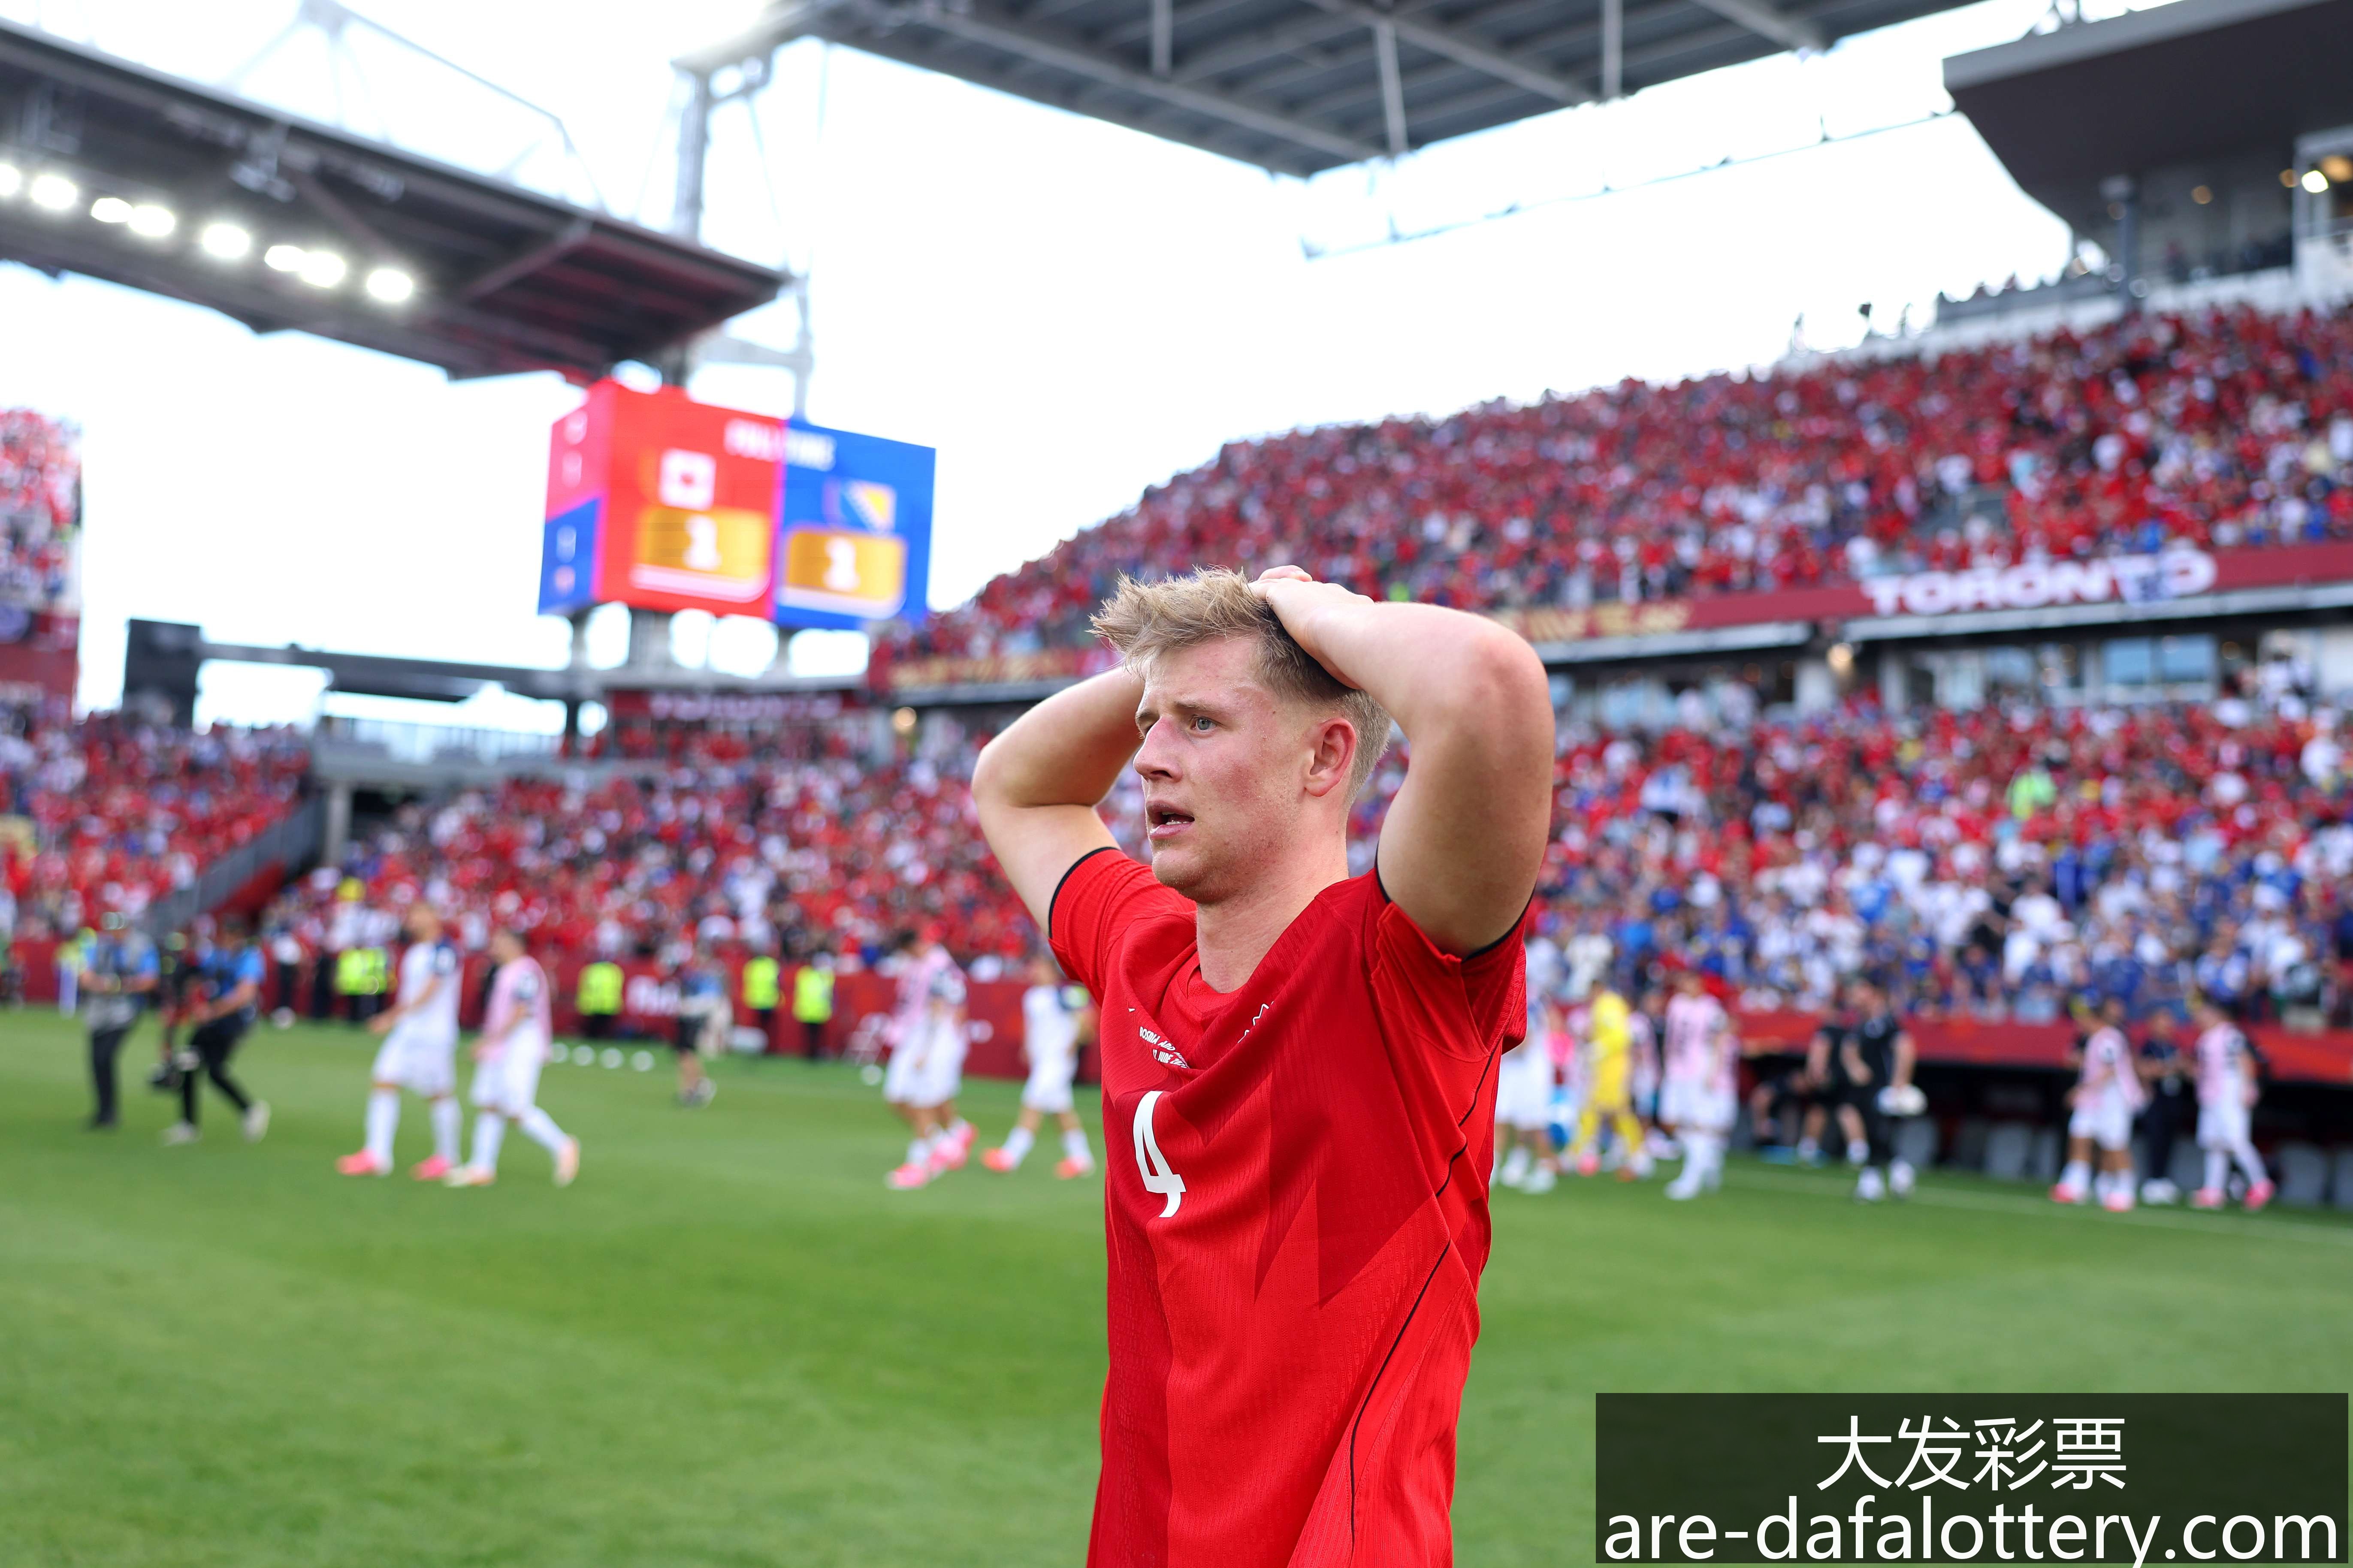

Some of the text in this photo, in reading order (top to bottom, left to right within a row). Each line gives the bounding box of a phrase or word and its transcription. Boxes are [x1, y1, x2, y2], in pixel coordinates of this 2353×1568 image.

[683, 516, 721, 571] 1
[824, 536, 860, 591] 1
[1860, 549, 2216, 615] TORONTO
[1139, 1026, 1160, 1044] BOSNIA
[1158, 1051, 1173, 1063] JUNE
[1133, 1090, 1187, 1218] 4
